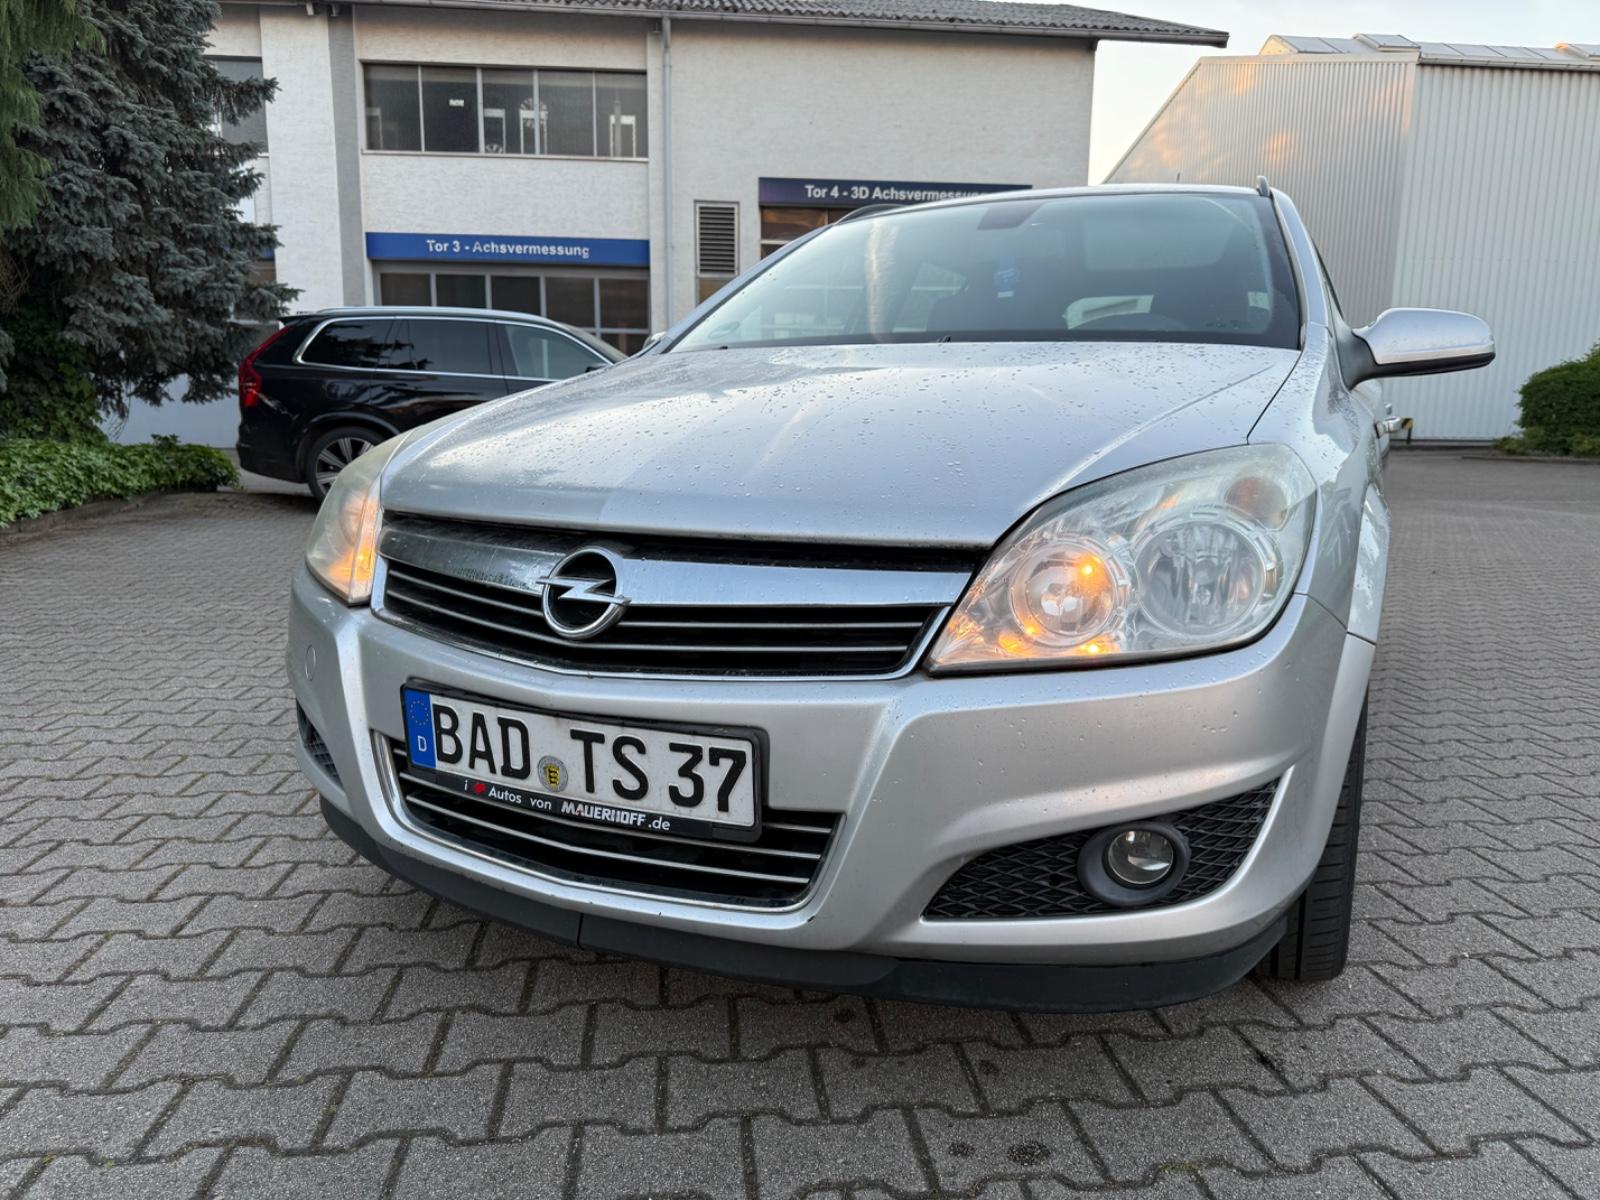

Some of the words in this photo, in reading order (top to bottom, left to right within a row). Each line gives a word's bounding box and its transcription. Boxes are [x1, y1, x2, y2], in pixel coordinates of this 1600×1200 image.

[805, 185, 828, 198] Tor
[830, 185, 839, 198] 4
[851, 186, 870, 199] 3D
[426, 240, 449, 252] Tor
[452, 240, 460, 252] 3
[472, 241, 589, 258] Achsvermessung
[418, 735, 428, 752] D
[434, 704, 531, 780] BAD
[570, 729, 649, 801] TS
[668, 742, 747, 813] 37
[488, 786, 522, 804] Autos
[530, 798, 552, 810] von
